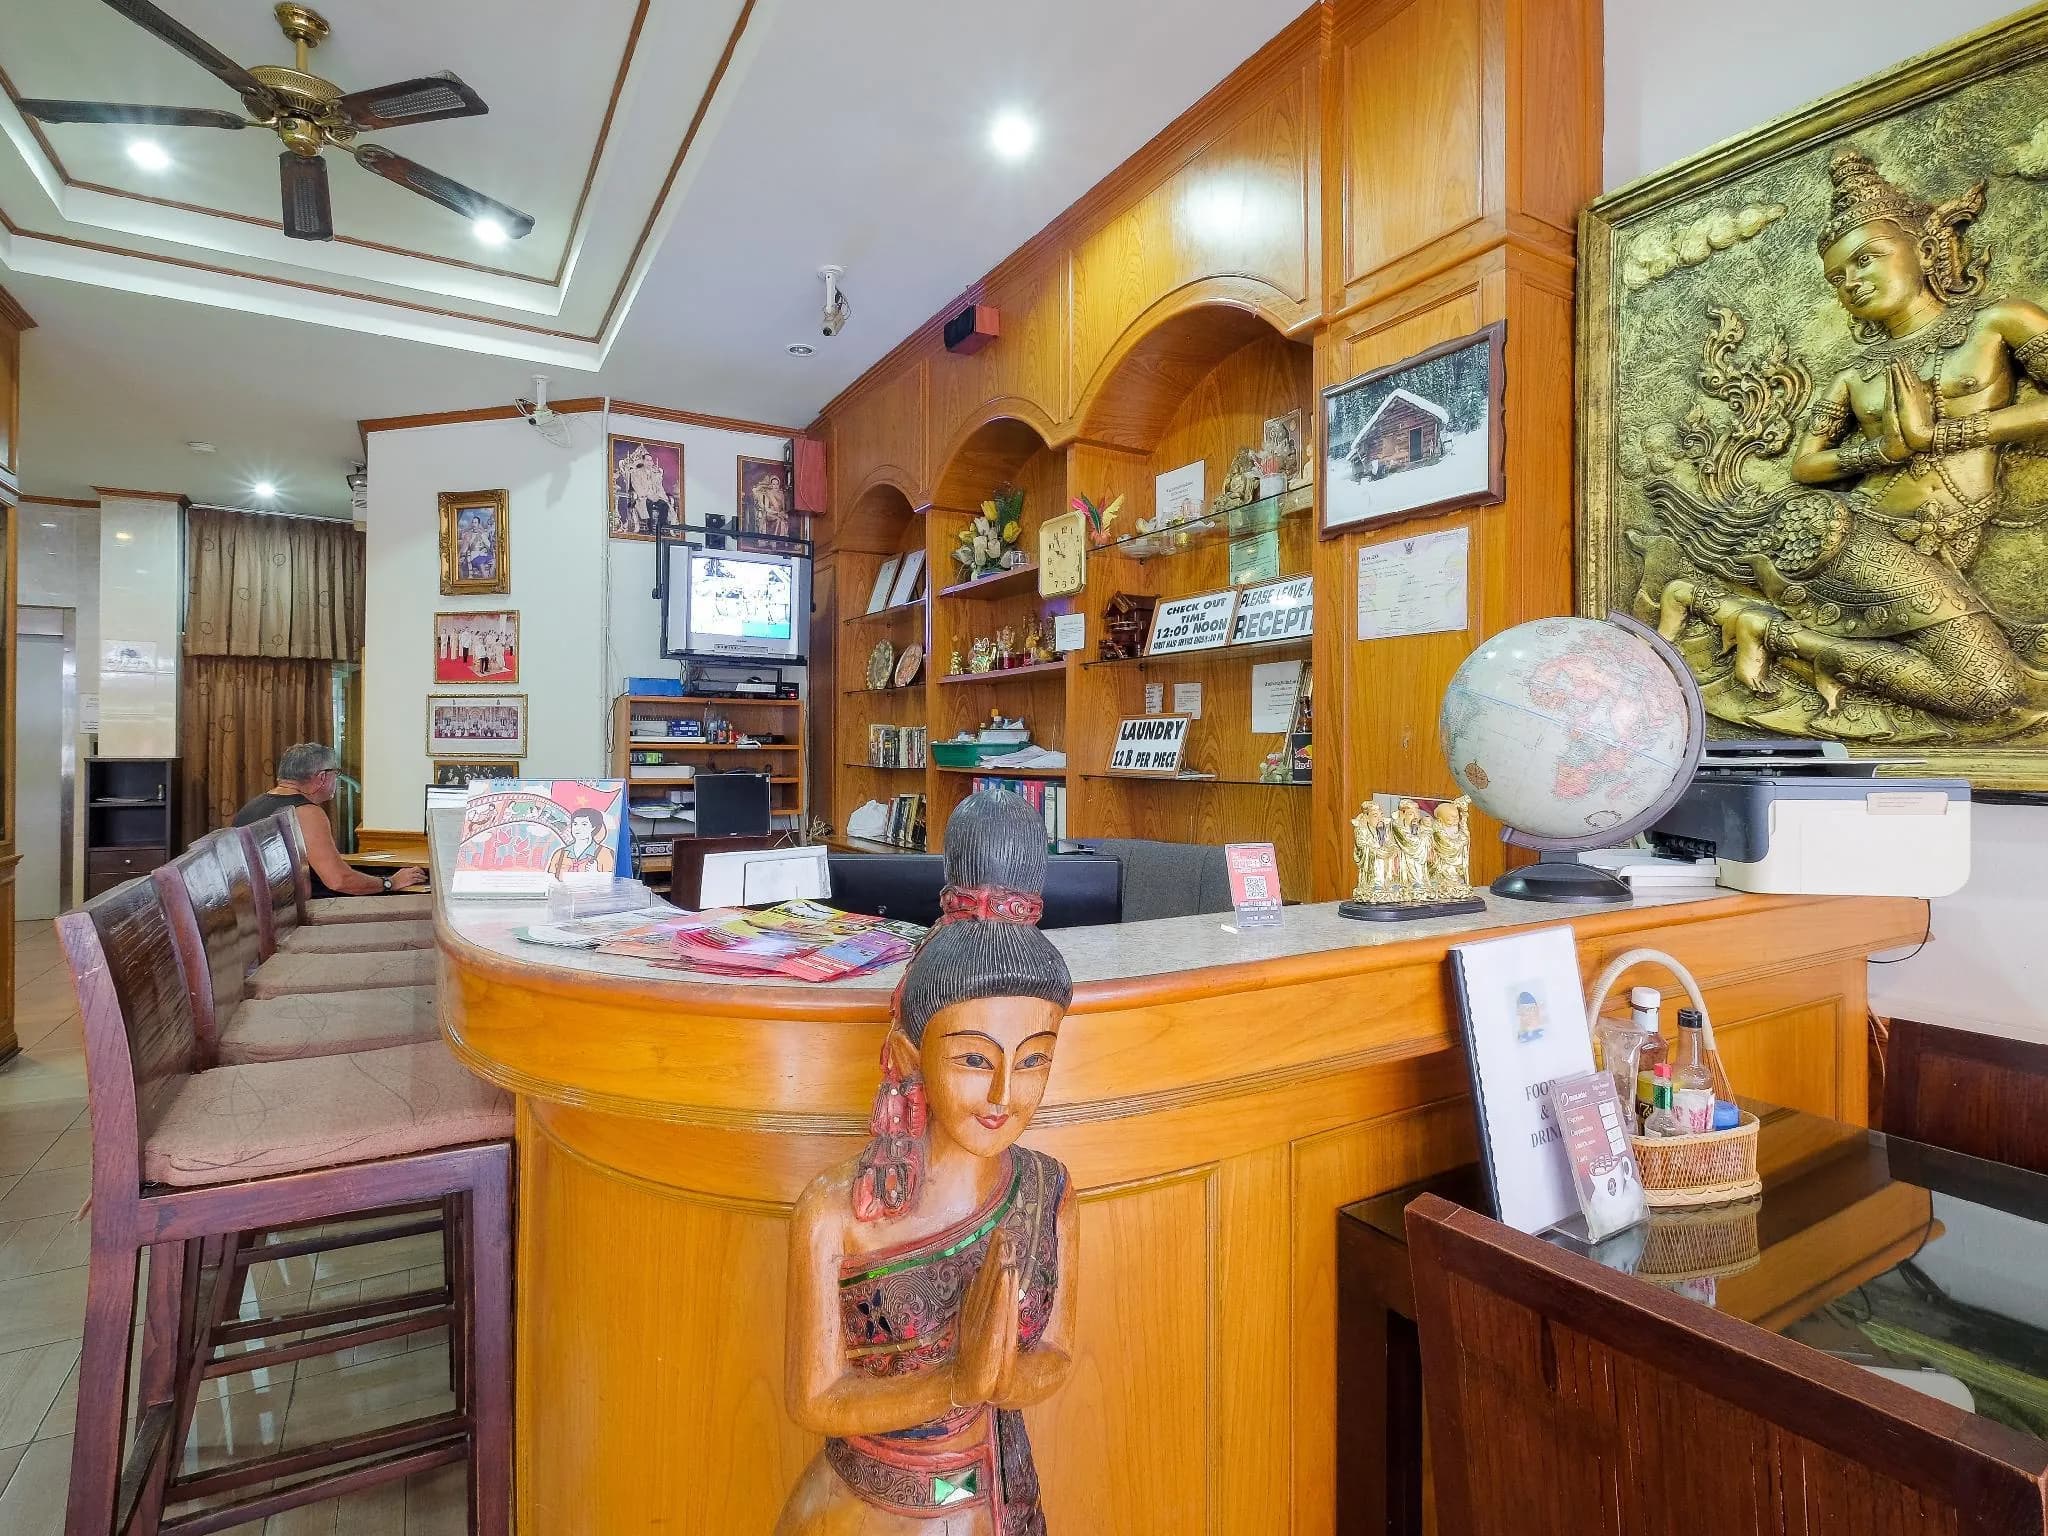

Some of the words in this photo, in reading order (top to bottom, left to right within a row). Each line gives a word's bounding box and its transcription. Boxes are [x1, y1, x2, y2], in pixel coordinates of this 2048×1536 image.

[1166, 602, 1201, 616] CHECK
[1203, 597, 1227, 610] OUT
[1239, 588, 1274, 609] PLEASE
[1276, 582, 1308, 601] LEAVE
[1156, 624, 1188, 640] 12:00
[1192, 618, 1229, 634] NOON
[1181, 612, 1207, 624] TIME
[1232, 604, 1313, 640] RECEPT
[1120, 719, 1185, 741] LAUNDRY
[1134, 751, 1150, 768] PER
[1151, 751, 1177, 768] PIECE
[1540, 1104, 1550, 1120] &
[1530, 1126, 1560, 1148] DRIN
